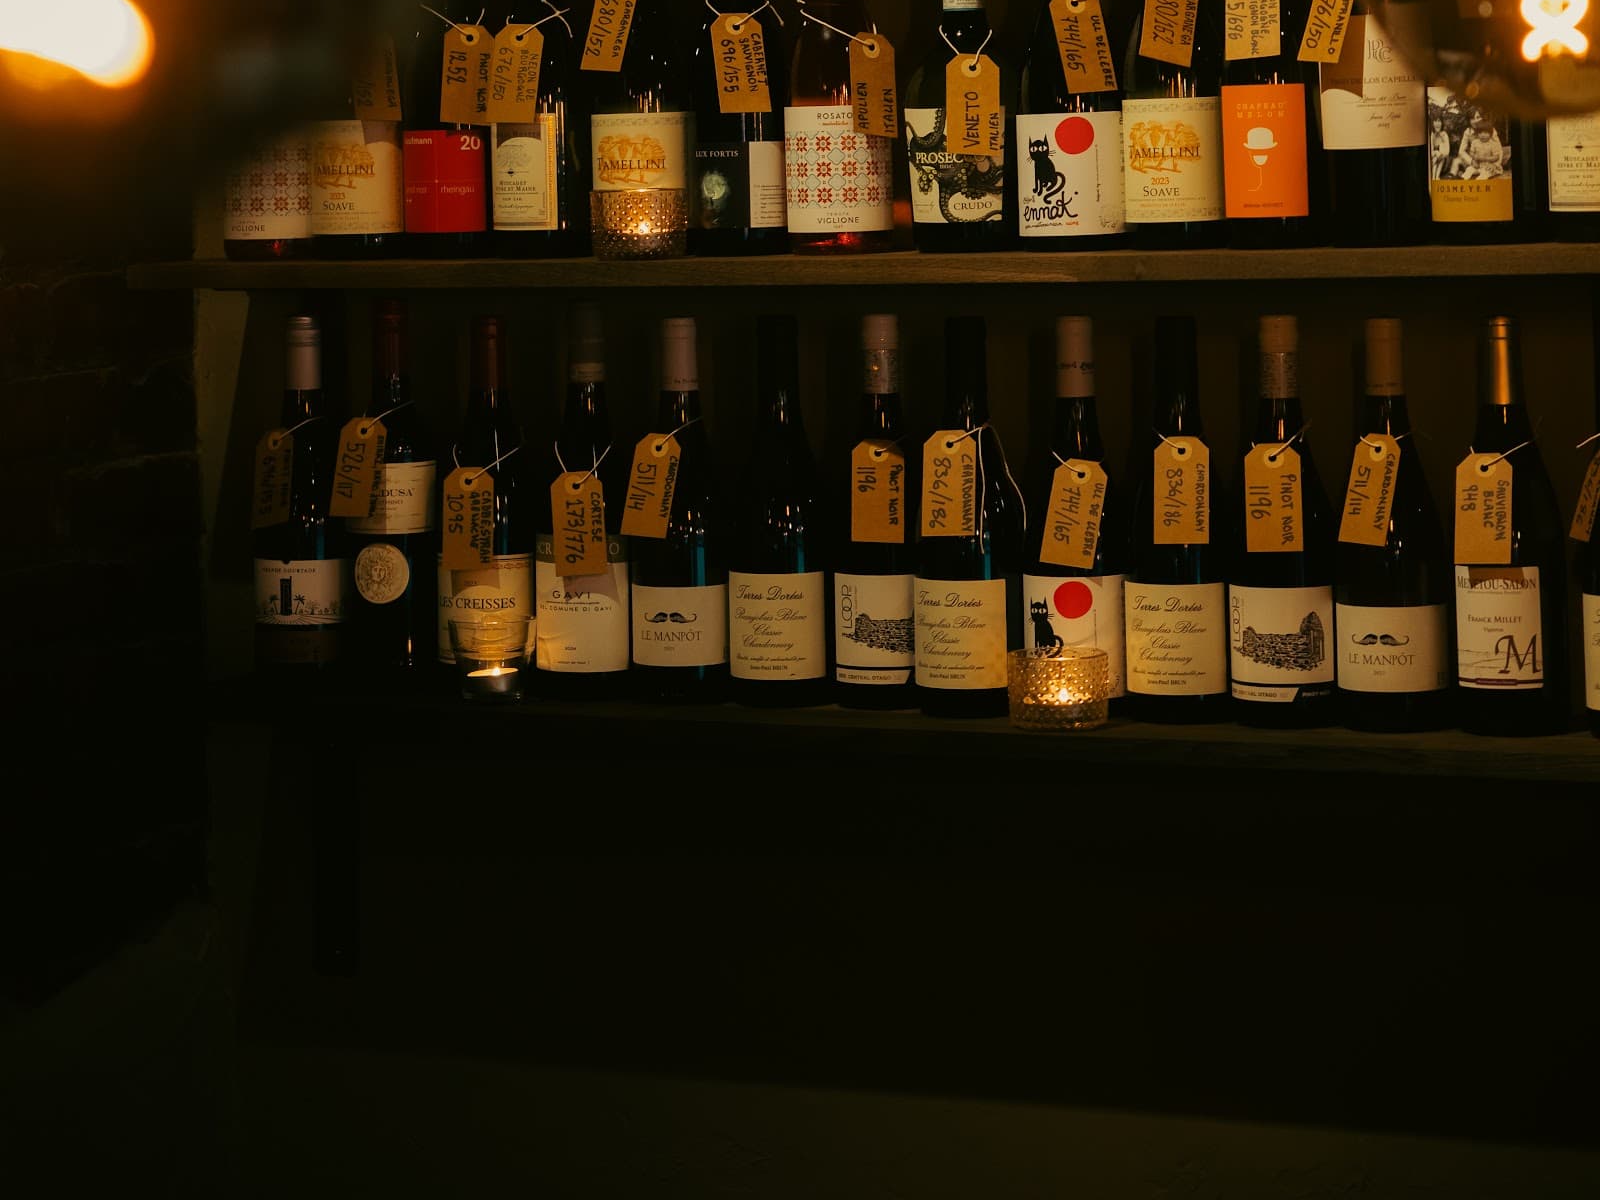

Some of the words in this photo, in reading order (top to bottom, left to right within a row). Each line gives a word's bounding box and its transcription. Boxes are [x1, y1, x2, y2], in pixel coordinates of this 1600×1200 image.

[611, 0, 633, 58] GARGANEGA
[1091, 15, 1101, 32] ULL
[1268, 13, 1277, 24] DE
[751, 32, 768, 87] CABERNET
[1060, 15, 1087, 75] 744/165
[1249, 30, 1260, 55] BLANC
[447, 50, 467, 84] 1252
[479, 53, 490, 82] PINOT
[492, 47, 515, 101] 676/150
[516, 49, 530, 103] BOURGOGNE
[527, 53, 539, 84] MELON
[721, 39, 741, 93] 696/155
[738, 38, 758, 92] SAUVIGNON
[477, 88, 488, 112] NOIR
[817, 112, 853, 120] ROSATO
[858, 82, 869, 129] APULIEN
[883, 88, 894, 133] ITALIEN
[963, 91, 979, 149] VENETO
[989, 112, 999, 151] ITALIEN
[459, 135, 481, 150] 20
[1129, 145, 1201, 159] TAMELLINI
[597, 157, 666, 171] TAMELLINI
[1151, 177, 1170, 185] 2023
[323, 201, 355, 211] SOAVE
[440, 185, 475, 194] rheingau
[953, 200, 993, 211] CRUDO
[1144, 186, 1180, 197] SOAVE
[336, 442, 366, 499] 526/117
[627, 462, 657, 510] 511/114
[659, 455, 678, 519] CHARDONNAY
[856, 466, 877, 493] 1196
[928, 456, 953, 529] 836/186
[961, 453, 974, 533] CHARDONNAY
[1094, 483, 1105, 499] ULL
[1163, 468, 1187, 527] 836/186
[1195, 463, 1206, 533] CHARDONNAY
[1248, 485, 1272, 520] 1196
[1280, 474, 1297, 509] PINOT
[1348, 465, 1371, 515] 511/114
[1374, 453, 1396, 531] CHARDONNAY
[1461, 484, 1479, 512] 948
[447, 494, 464, 534] 1095
[590, 491, 603, 542] CORTESE
[889, 498, 899, 525] NOIR
[1053, 486, 1081, 544] 744/165
[1483, 491, 1494, 528] BLANC
[1495, 479, 1510, 541] SAUVIGNON
[563, 499, 589, 564] 173/776
[1281, 516, 1295, 545] NOIR
[553, 590, 590, 599] GAVI
[1457, 576, 1536, 591] MENETOU-SALON
[456, 596, 516, 609] CREISSES
[842, 584, 852, 628] LOOP
[1467, 614, 1492, 623] FRANCK
[1494, 615, 1522, 623] MILLET
[641, 630, 652, 641] LE
[654, 629, 703, 641] MANPÔT
[1349, 653, 1360, 664] LE
[1363, 654, 1416, 665] MANPÔT
[1495, 634, 1541, 674] M
